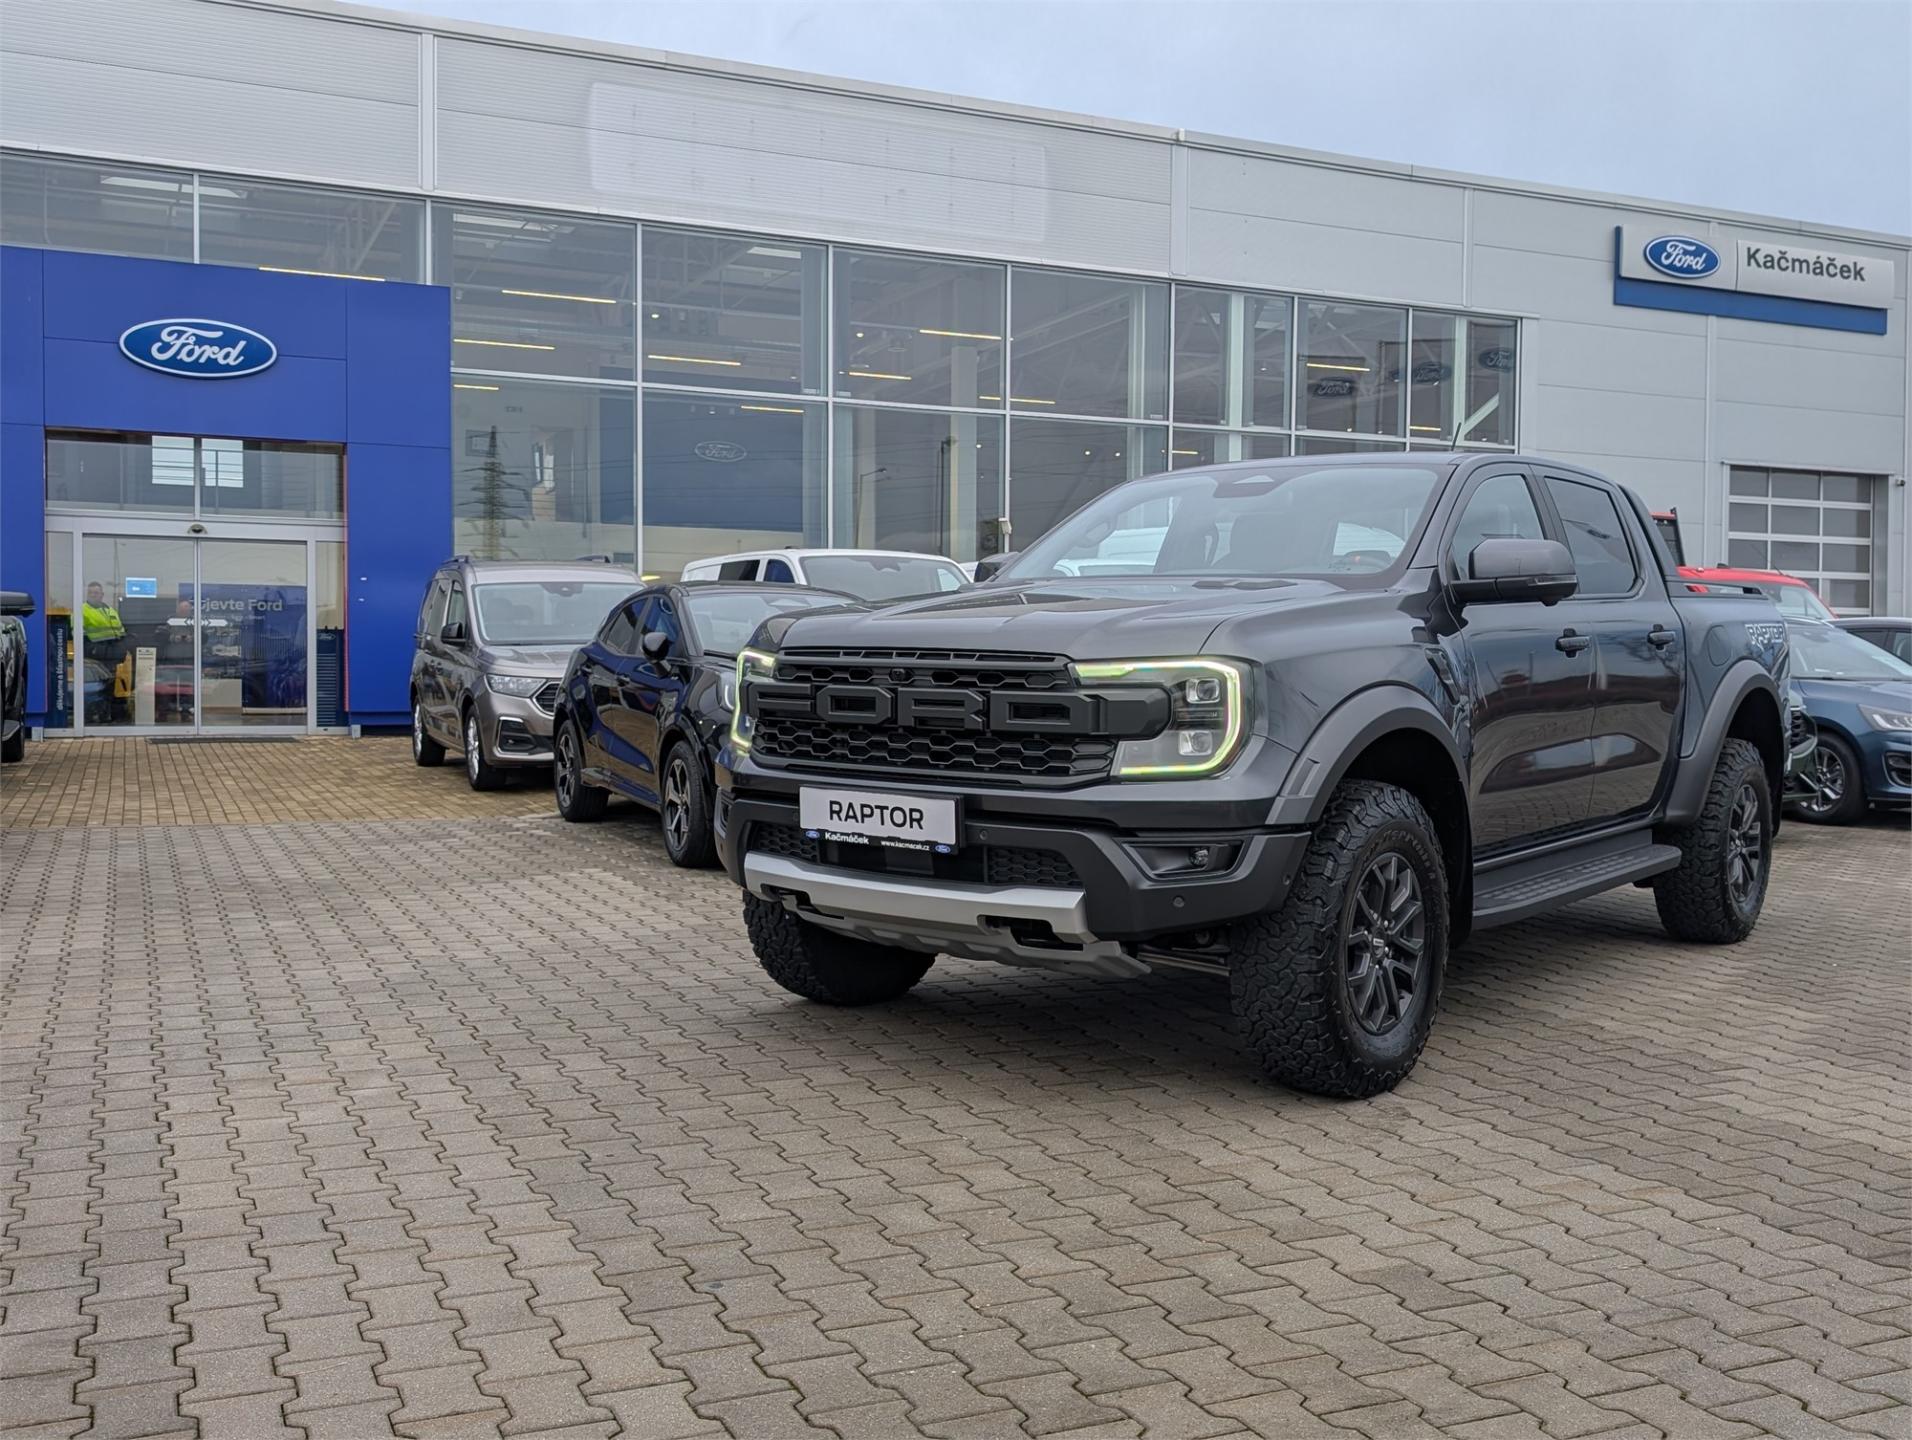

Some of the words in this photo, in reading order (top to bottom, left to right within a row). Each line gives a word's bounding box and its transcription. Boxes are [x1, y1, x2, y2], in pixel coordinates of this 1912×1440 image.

[1661, 241, 1706, 270] Ford
[1747, 247, 1865, 281] Kačmáček
[151, 326, 247, 366] Ford
[248, 599, 283, 612] Ford
[747, 682, 1098, 735] FORD
[829, 800, 924, 830] RAPTOR
[825, 831, 869, 845] Kačmáček
